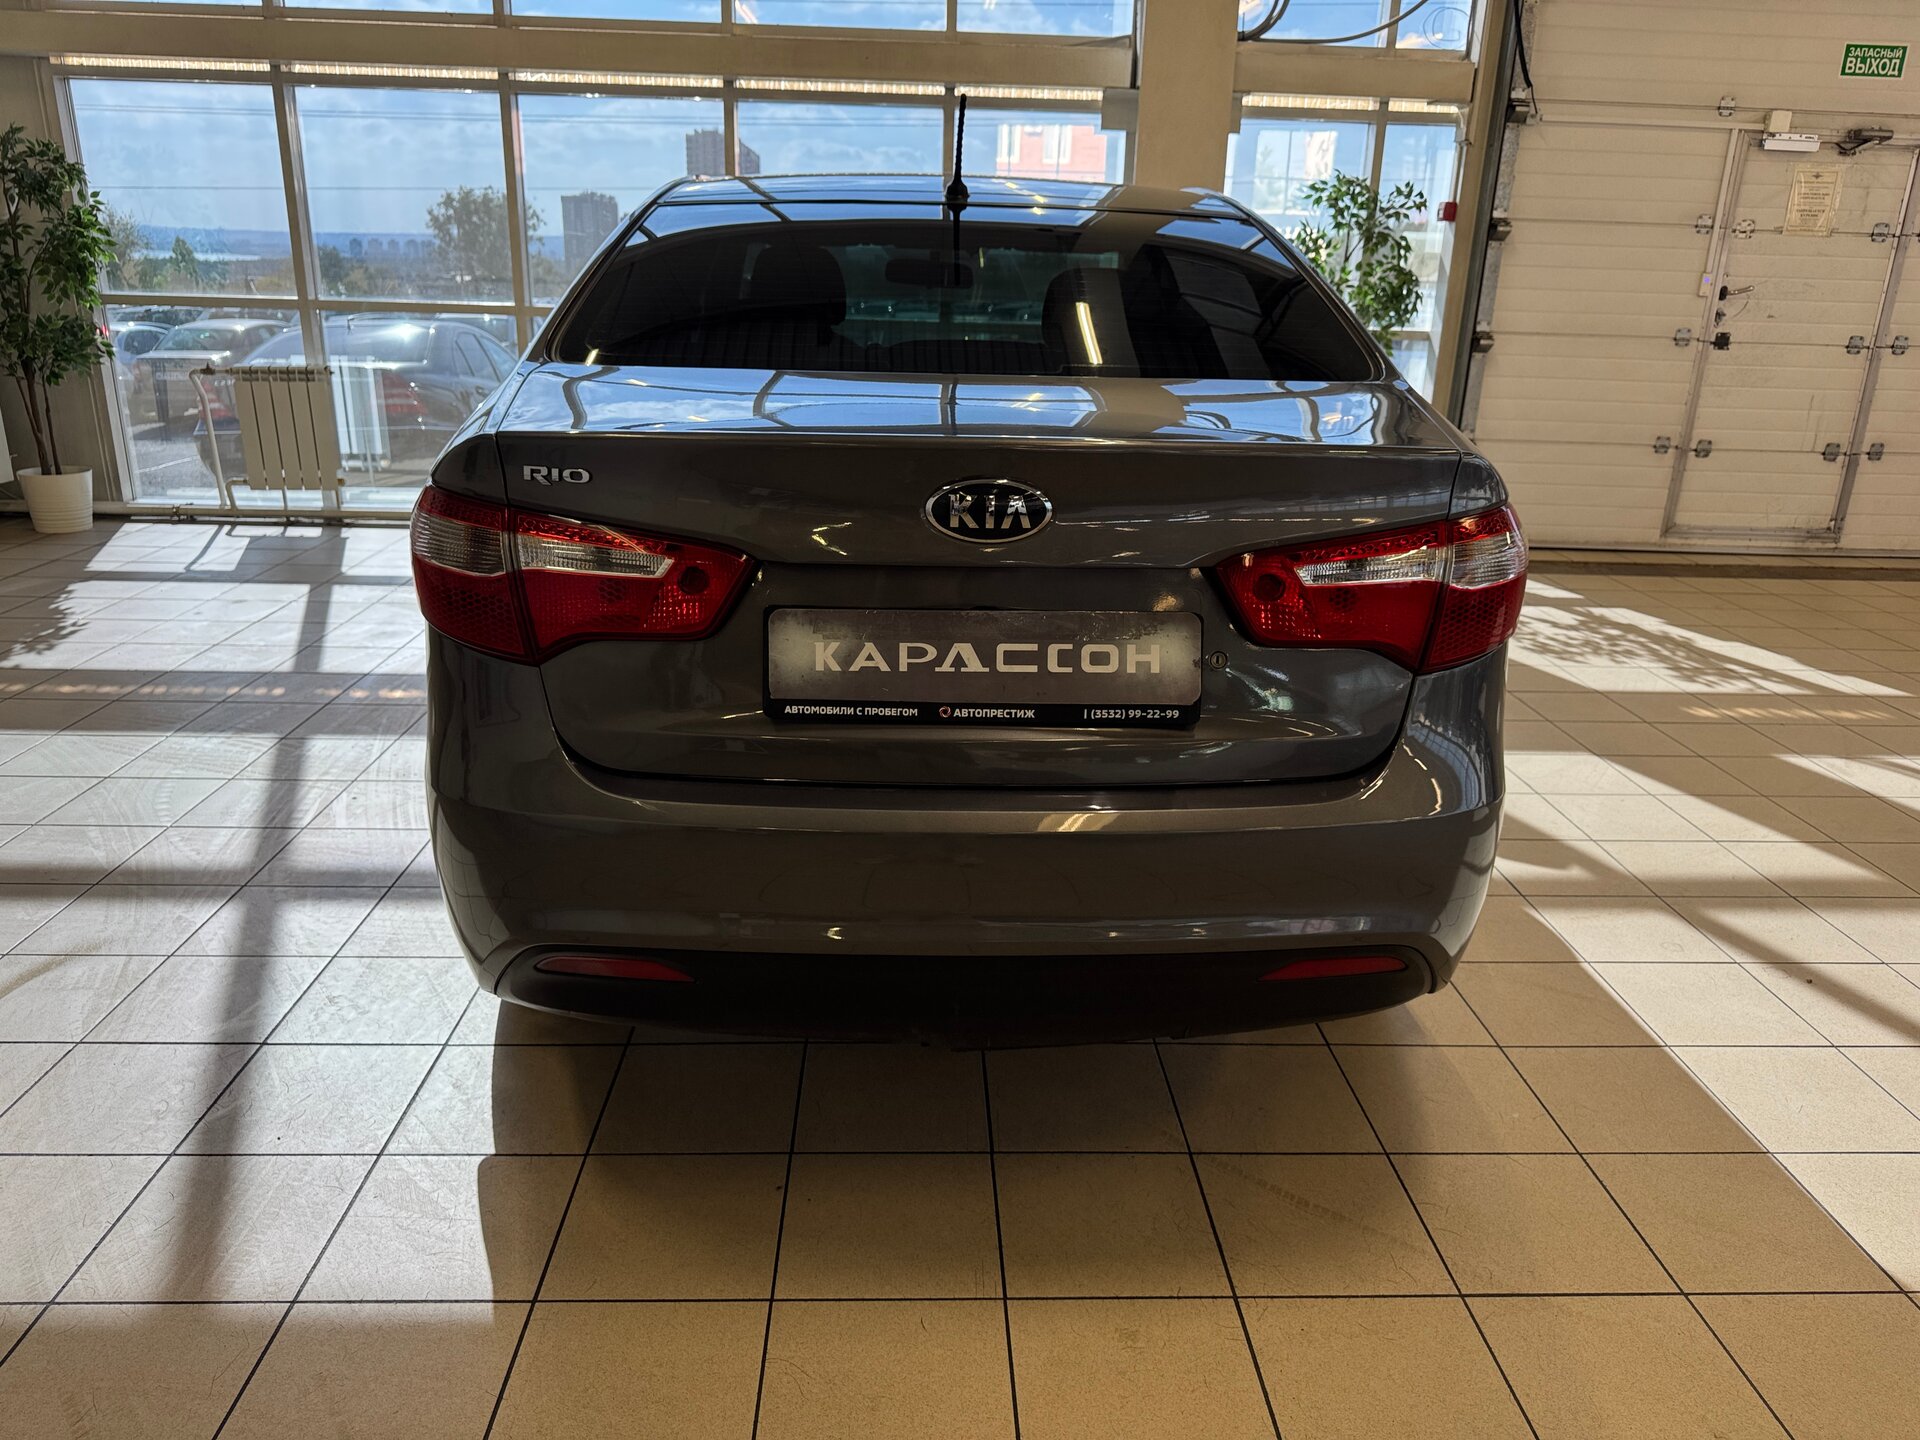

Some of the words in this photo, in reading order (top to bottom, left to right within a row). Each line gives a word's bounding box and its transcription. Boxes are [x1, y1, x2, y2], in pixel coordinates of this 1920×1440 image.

[1848, 47, 1903, 58] ЗАПАСНЫЙ
[1845, 57, 1900, 76] ВЫХОД
[523, 465, 590, 485] RIO
[949, 494, 1031, 529] KIA
[784, 705, 854, 716] АВТОМОБИЛИ
[856, 707, 863, 716] С
[864, 707, 918, 717] ПРОБЕГОМ
[953, 708, 1035, 719] АВТОПРЕСТИЖ
[1090, 709, 1126, 720] (3532)
[1128, 710, 1180, 719] 99-22-99
